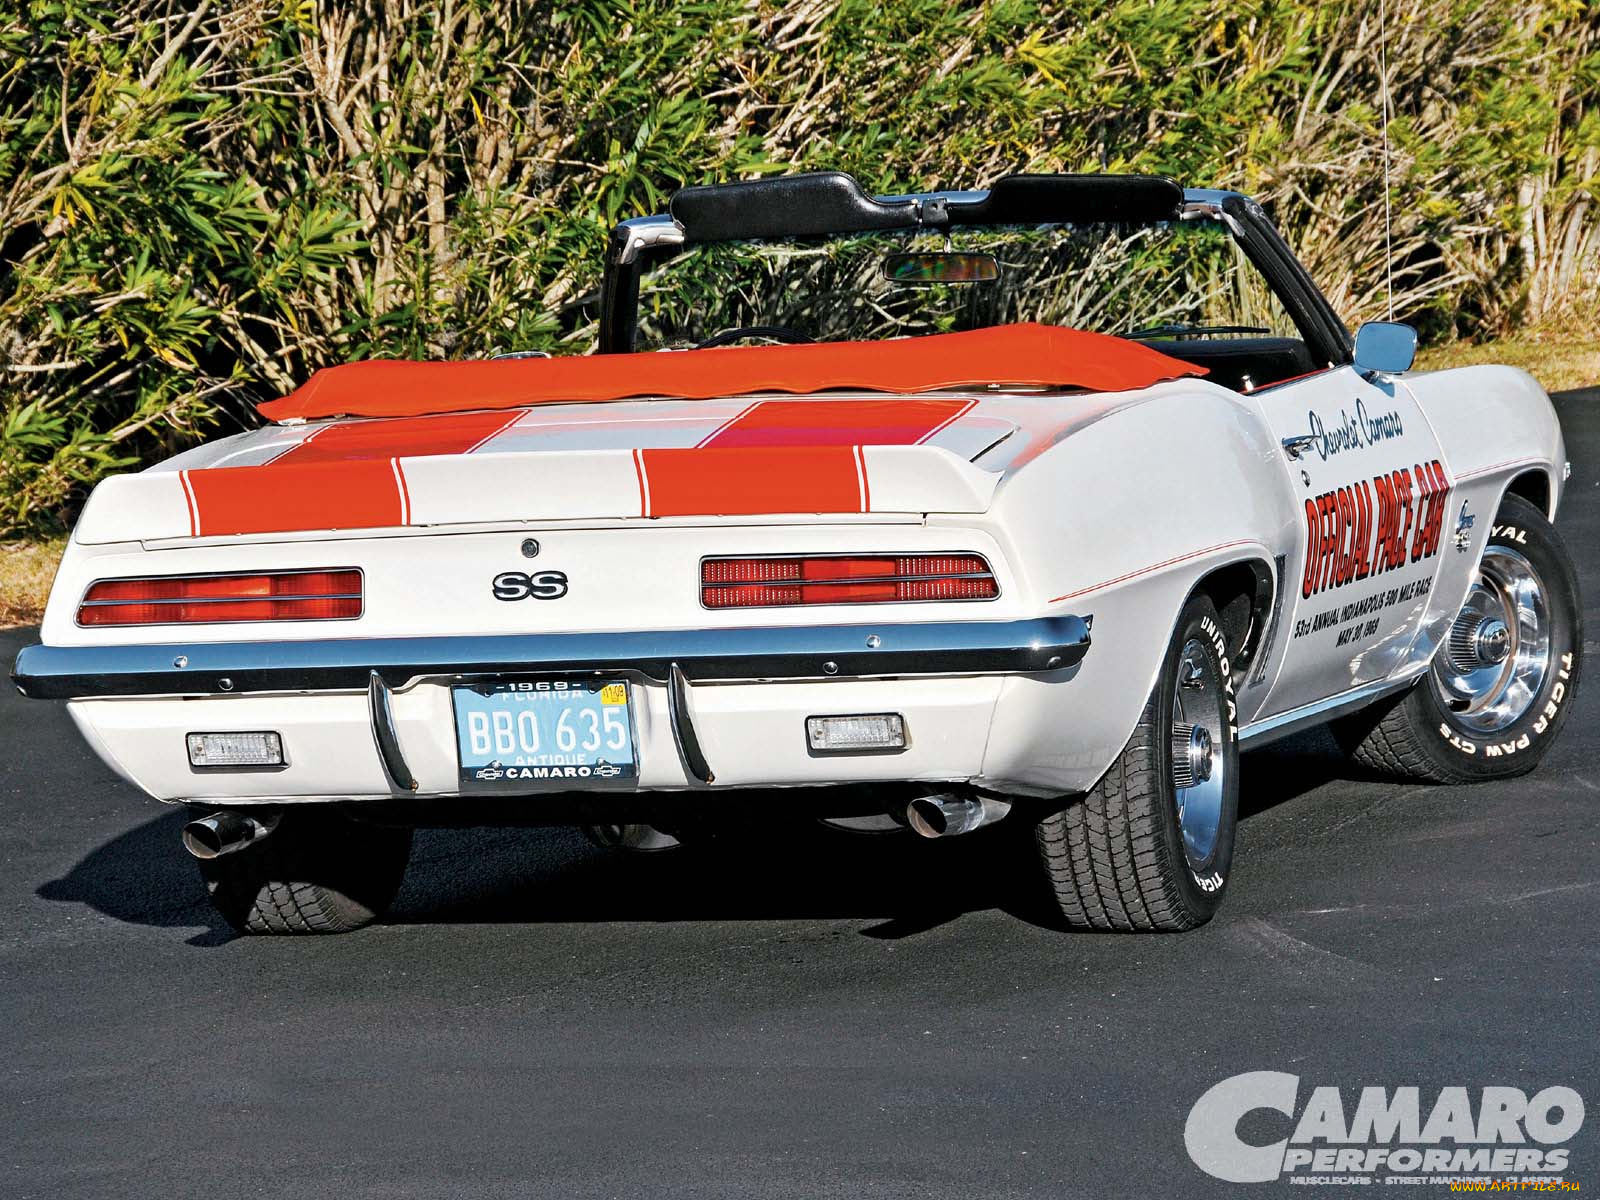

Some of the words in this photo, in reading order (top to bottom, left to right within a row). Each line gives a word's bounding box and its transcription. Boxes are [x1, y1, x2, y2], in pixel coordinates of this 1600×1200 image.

[1309, 410, 1364, 461] Chevrolet
[1356, 398, 1403, 446] Camaro
[1302, 479, 1373, 600] OFFICIAL
[1370, 468, 1413, 577] PACE
[1411, 459, 1450, 563] CAR
[492, 570, 569, 602] SS
[1311, 608, 1341, 633] ANNUAL
[1340, 592, 1384, 620] INDIANAPOLIS
[1384, 588, 1399, 607] 500
[1397, 581, 1416, 604] MILE
[1415, 576, 1433, 599] RACE
[1336, 626, 1354, 648] MAY
[1200, 616, 1238, 742] UNIROYAL
[1532, 652, 1573, 734] TIGER
[555, 708, 626, 751] 635
[1486, 733, 1530, 757] PAW
[506, 766, 591, 779] CAMARO
[515, 754, 586, 766] ANTIQUE
